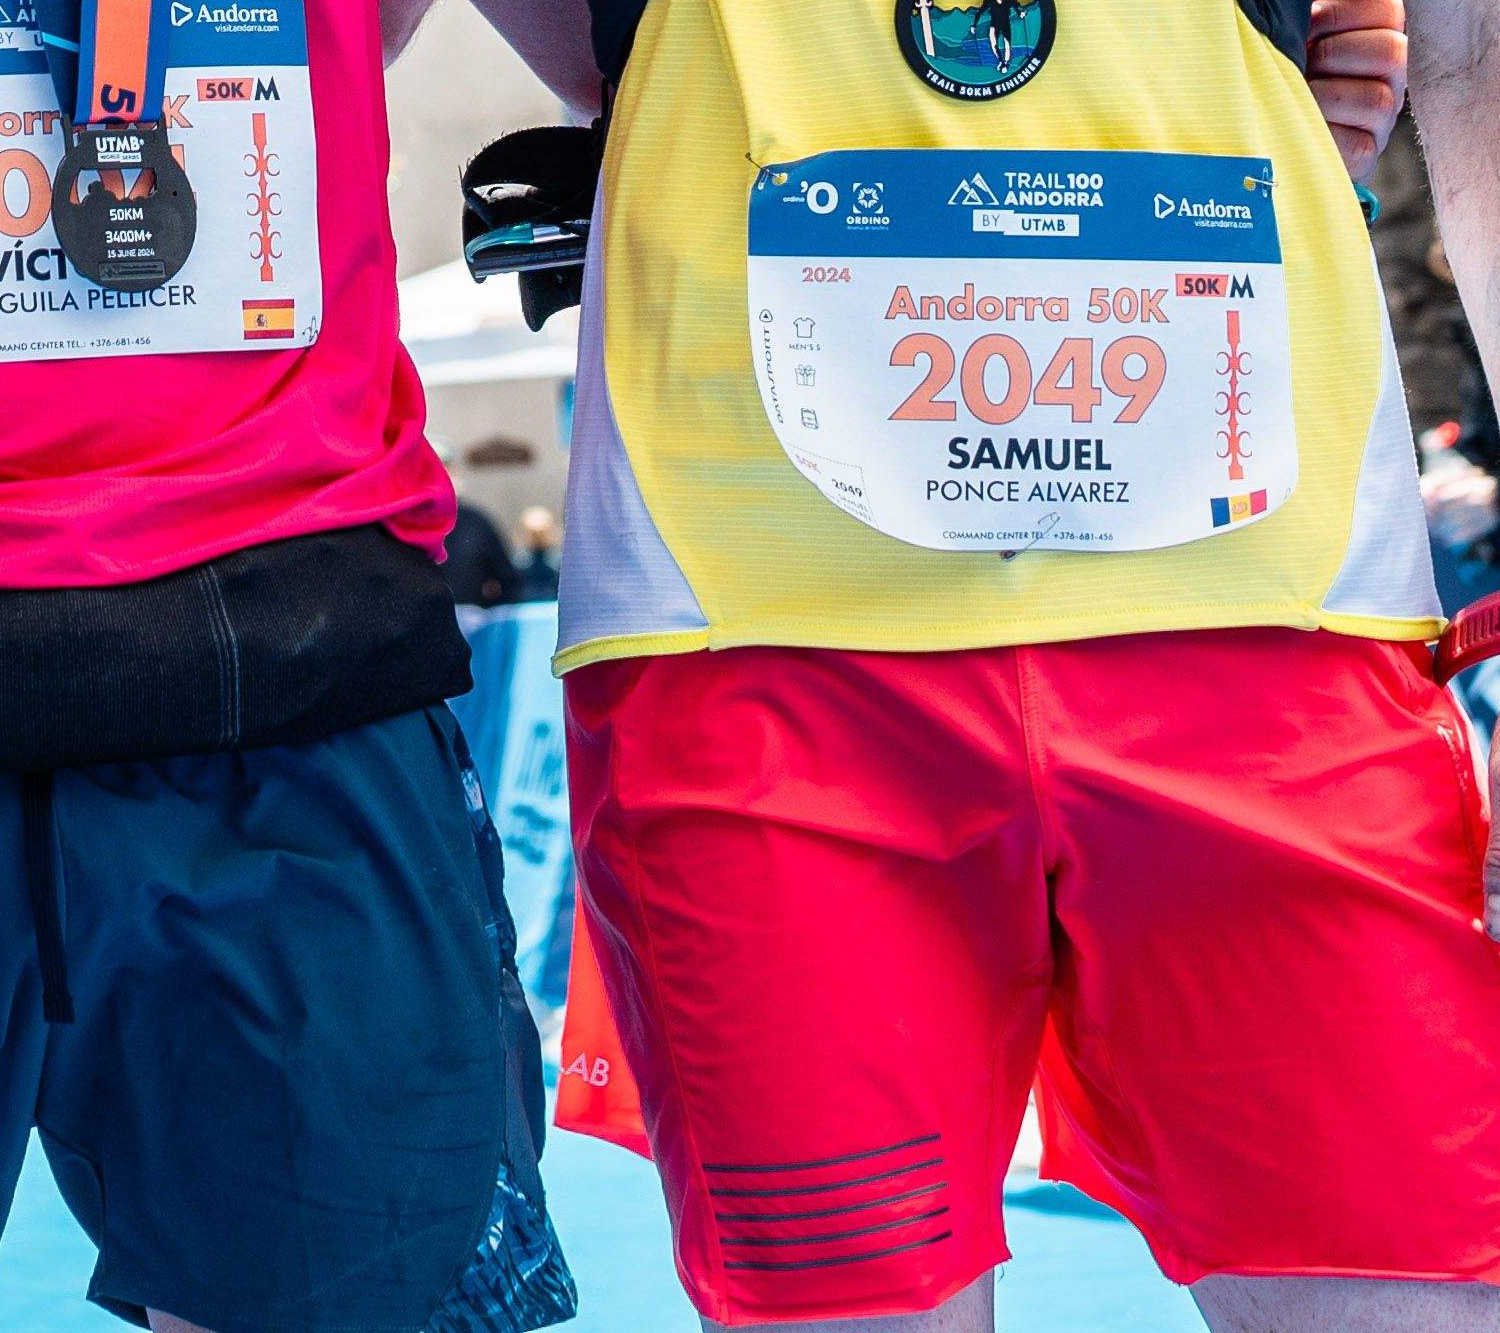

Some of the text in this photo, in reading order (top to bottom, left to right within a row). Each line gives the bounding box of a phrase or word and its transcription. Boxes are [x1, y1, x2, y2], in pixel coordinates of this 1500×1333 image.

[195, 3, 279, 23] Andorra
[926, 57, 1042, 97] TRAIL 50KM FINISHER
[205, 75, 281, 101] 50K M
[101, 84, 136, 124] 5
[95, 136, 140, 152] UTMB
[1004, 172, 1104, 190] TRAIL 100
[1003, 191, 1104, 208] ANDORRA
[1177, 197, 1252, 220] Andorra
[109, 208, 144, 221] 50KM
[845, 216, 890, 226] ORDINO
[982, 214, 1066, 233] BY UTMB
[105, 230, 153, 244] 3400M+
[117, 249, 136, 258] JUNE
[137, 248, 155, 257] 2024
[801, 266, 851, 284] 2024
[1183, 274, 1255, 299] 50K M
[87, 284, 197, 311] PELLICER
[885, 283, 1170, 324] Andorra 50K
[30, 339, 65, 351] CENTER
[90, 336, 151, 349] +376-681-456
[887, 333, 1168, 426] 2049
[947, 436, 1112, 471] SAMUEL
[926, 479, 1130, 503] PONCE ALVAREZ
[942, 530, 994, 540] COMMAND
[996, 531, 1029, 540] CENTER
[1054, 532, 1114, 542] +376-681-456
[560, 1051, 611, 1088] AB
